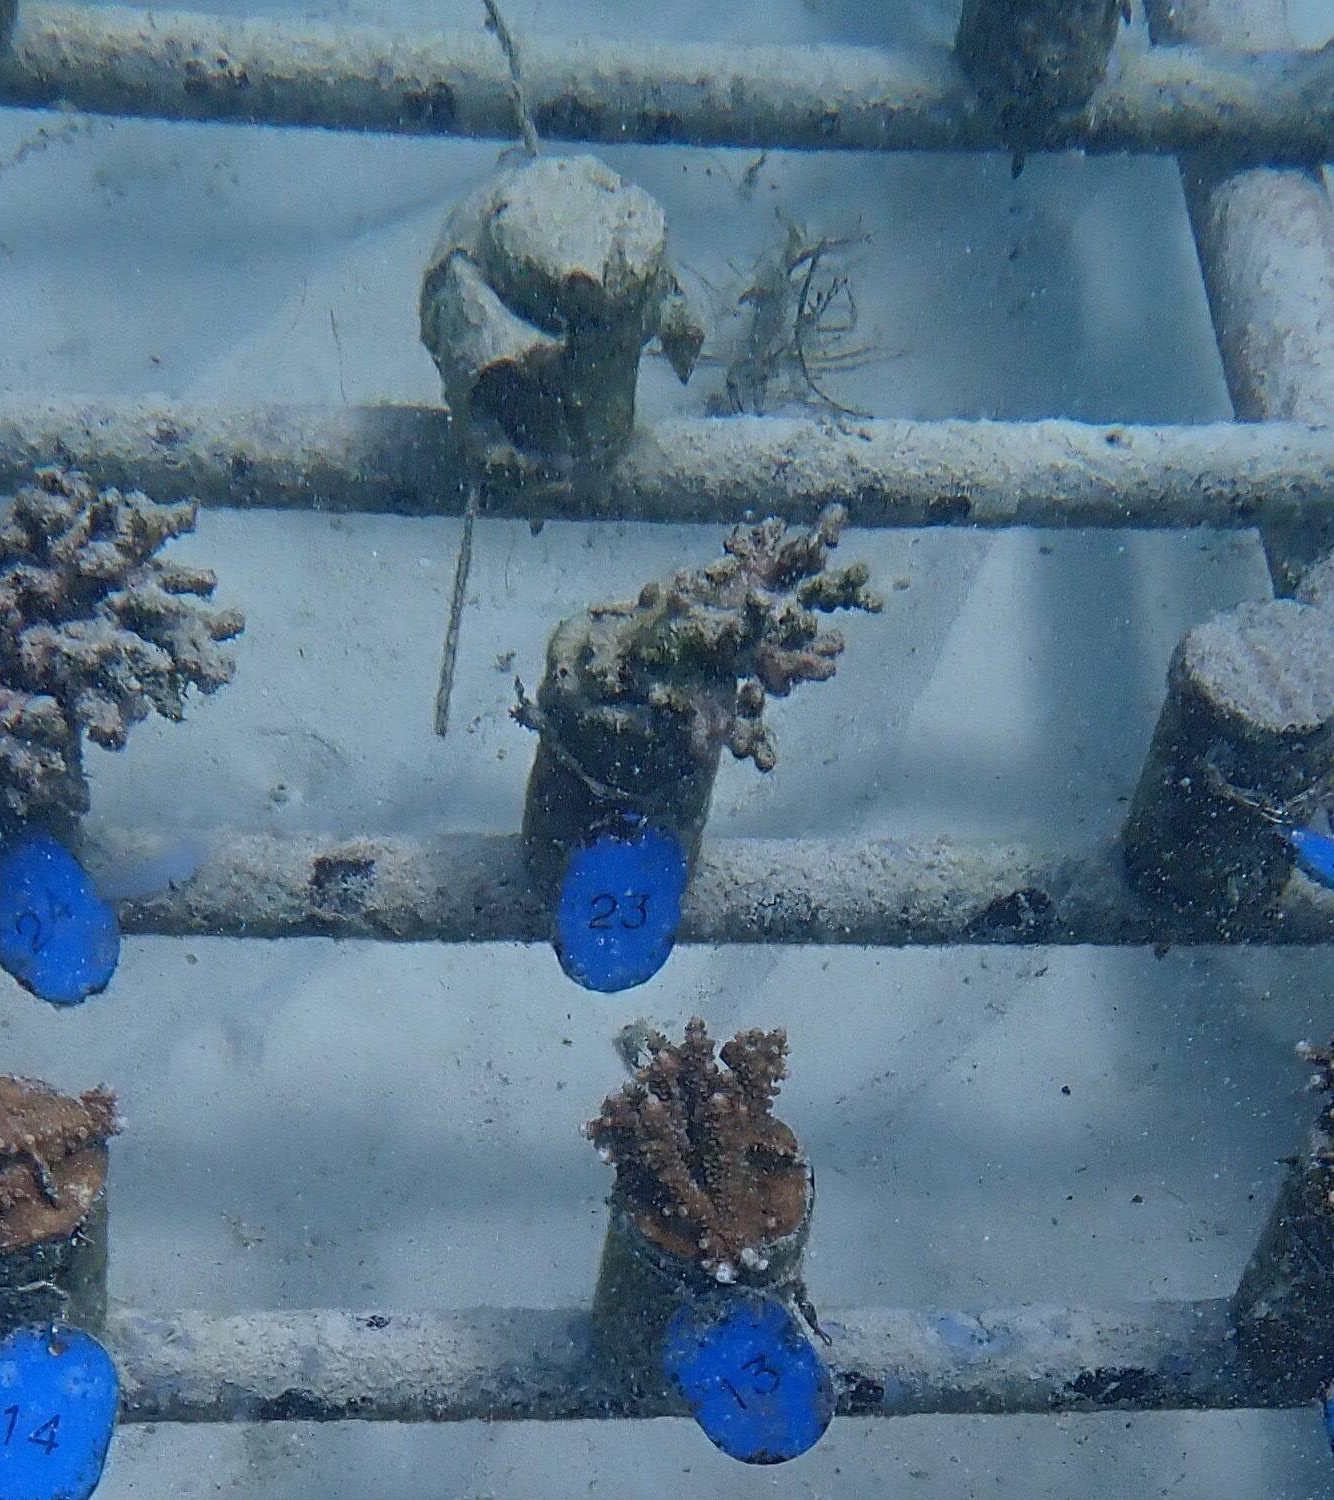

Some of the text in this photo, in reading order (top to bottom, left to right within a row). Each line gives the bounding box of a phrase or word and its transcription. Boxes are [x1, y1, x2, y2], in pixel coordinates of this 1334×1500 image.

[590, 893, 648, 931] 23
[720, 1349, 784, 1410] 13
[0, 1402, 61, 1456] 14
